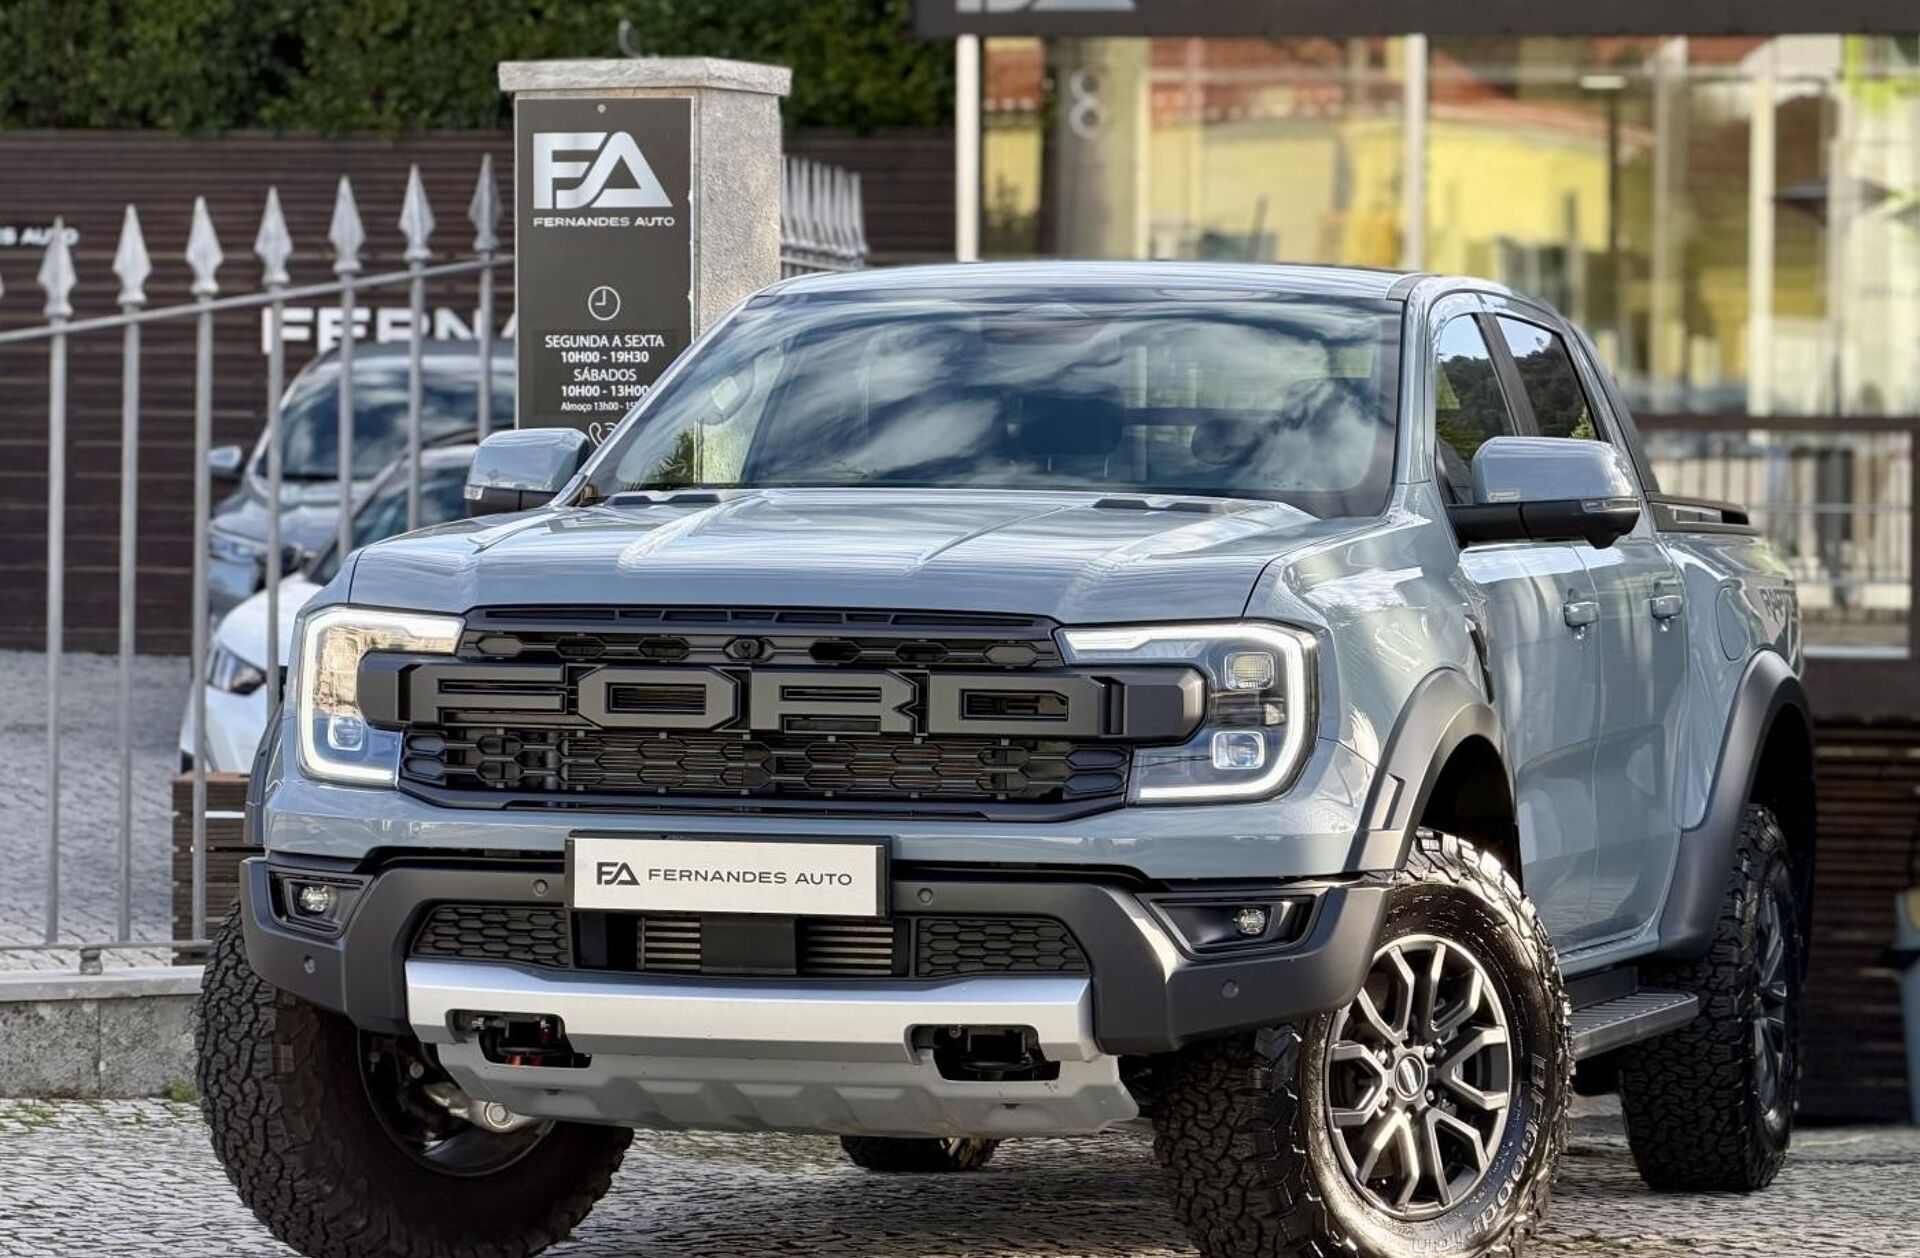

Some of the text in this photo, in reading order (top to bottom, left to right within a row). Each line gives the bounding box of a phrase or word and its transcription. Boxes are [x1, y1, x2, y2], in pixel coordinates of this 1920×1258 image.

[533, 131, 673, 209] FA
[533, 217, 676, 227] FERNANDES AUTO
[545, 335, 665, 348] SEGUNDA A SEXTA
[561, 351, 600, 363] 10H00
[610, 351, 650, 363] 19H30
[574, 367, 637, 381] SÁBADOS
[561, 386, 600, 397] 10H00
[561, 402, 592, 413] Almoço
[594, 401, 619, 411] 13h00
[409, 660, 1103, 736] FORD
[597, 862, 853, 886] FA FERNANDES AUTO
